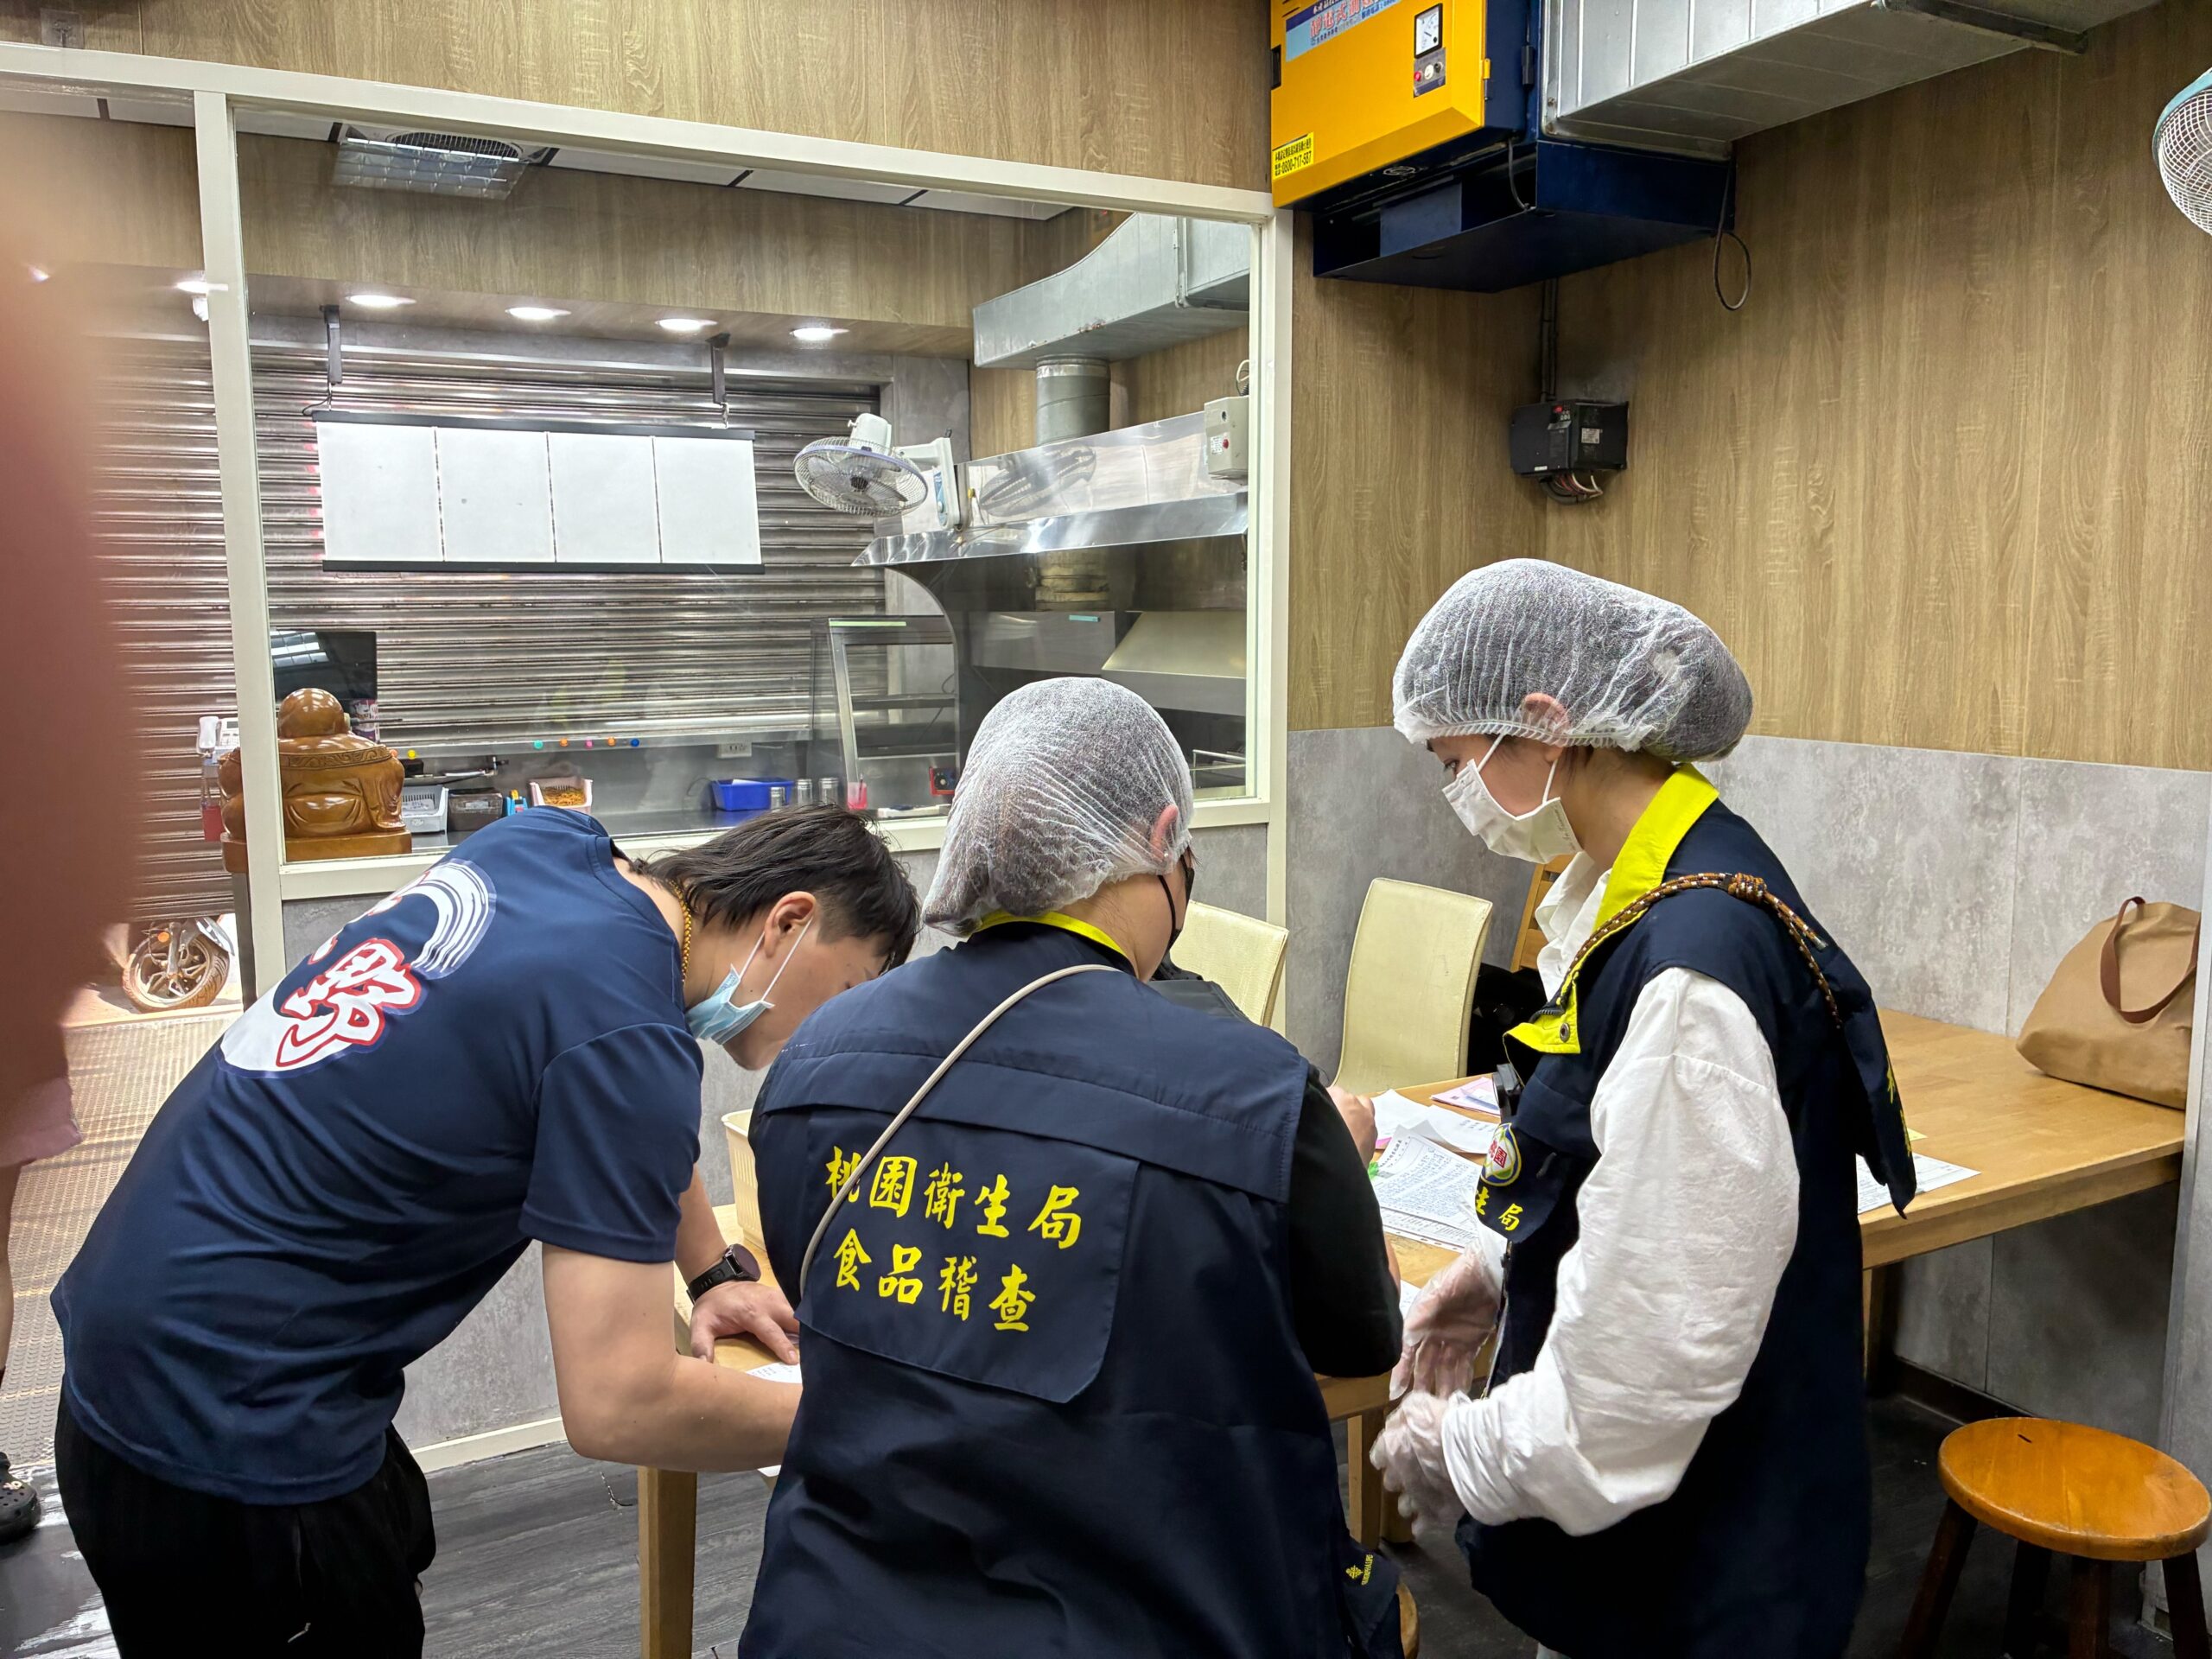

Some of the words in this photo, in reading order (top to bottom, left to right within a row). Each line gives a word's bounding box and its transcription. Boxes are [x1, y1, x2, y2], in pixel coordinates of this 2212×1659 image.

[825, 1146, 1082, 1249] 桃園衛生局
[833, 1228, 1036, 1332] 食品稽查
